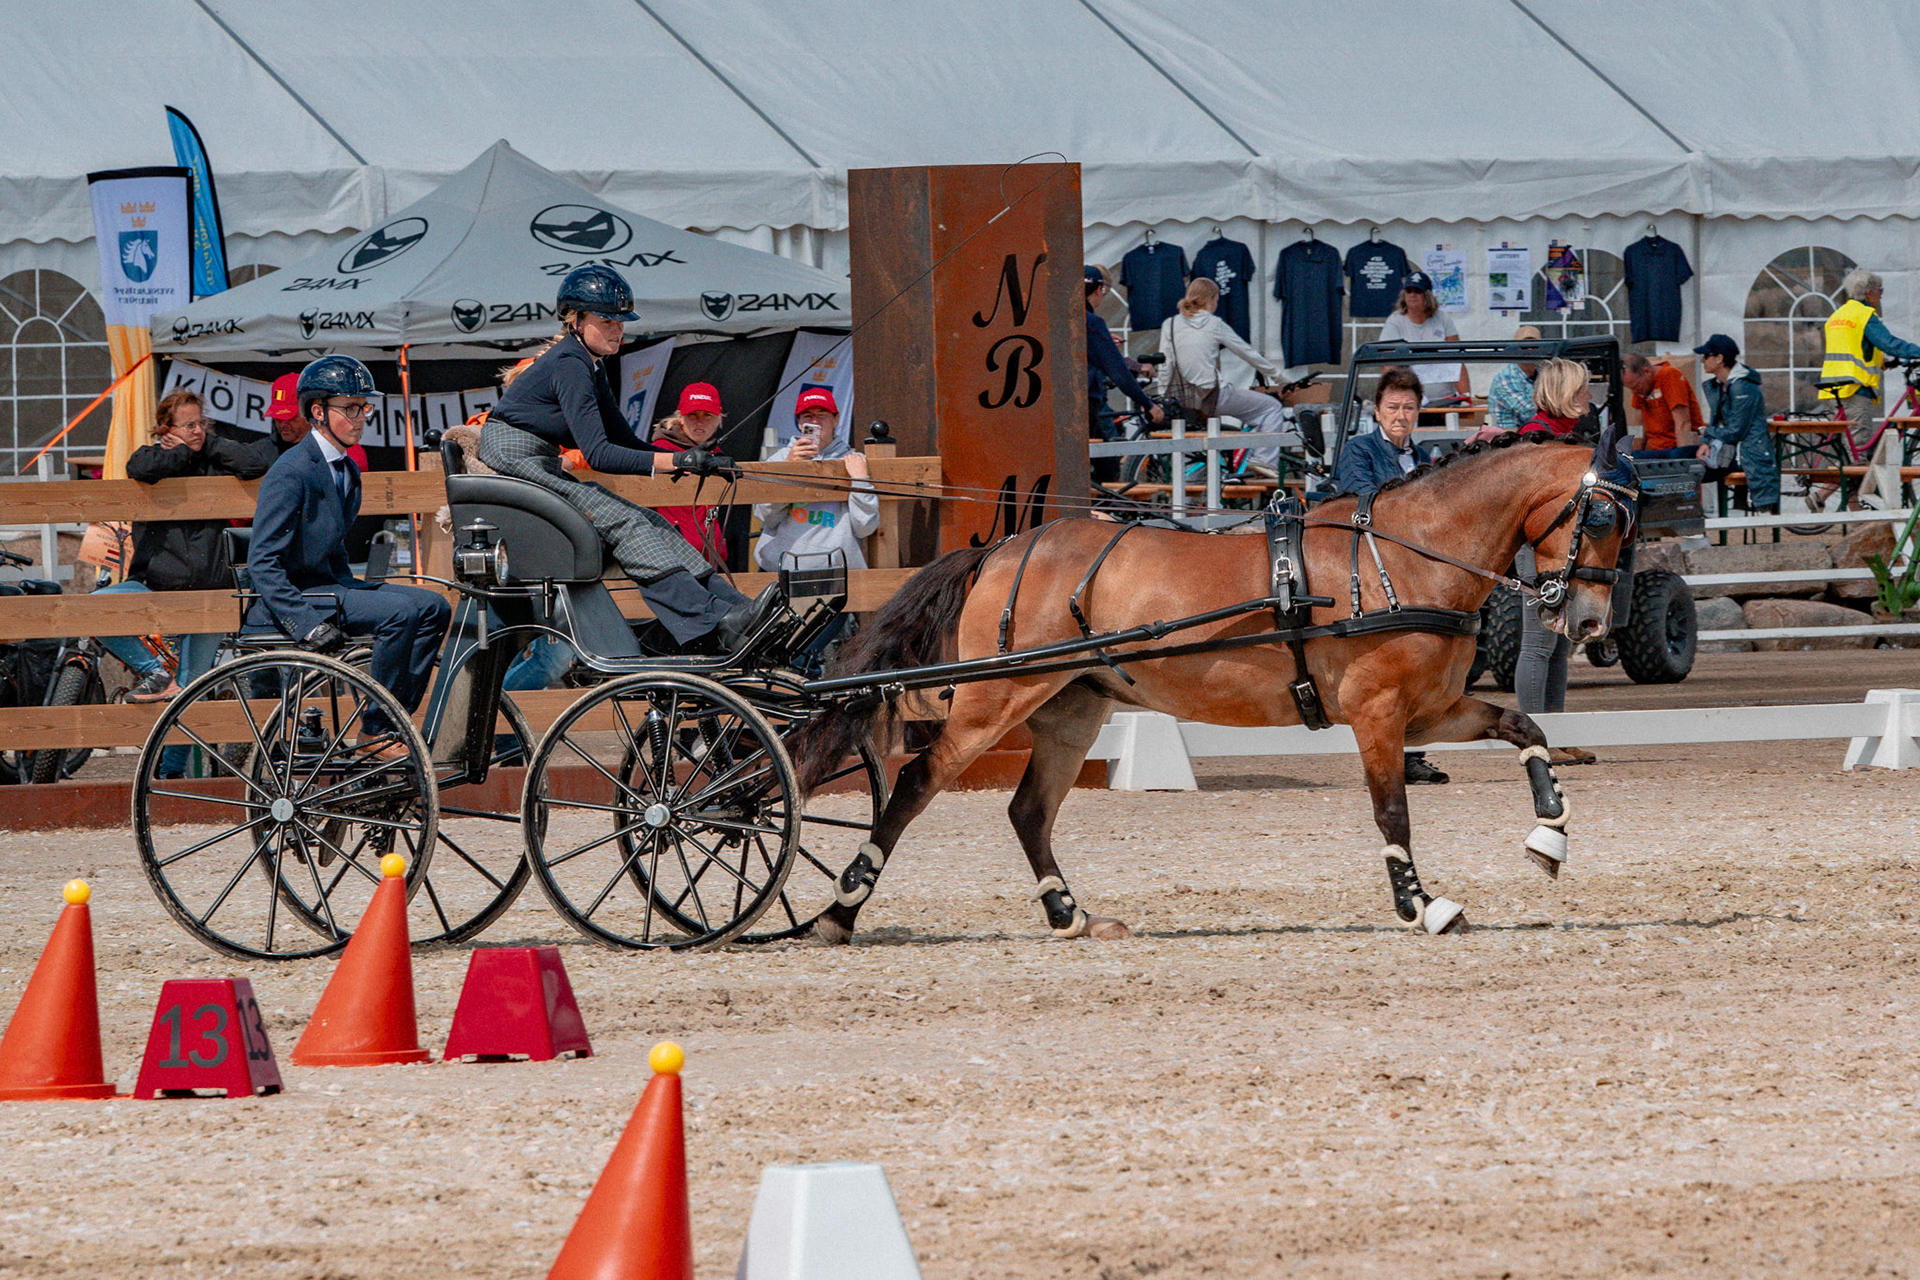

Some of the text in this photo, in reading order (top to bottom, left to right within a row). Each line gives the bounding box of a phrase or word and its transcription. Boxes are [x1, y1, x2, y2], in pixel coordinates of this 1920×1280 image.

[281, 278, 373, 292] 24MX
[738, 292, 841, 311] 24MX
[318, 311, 376, 330] 24MX
[490, 302, 557, 322] 24M
[787, 507, 836, 529] OUR
[158, 1003, 229, 1069] 13
[238, 997, 270, 1062] 13
